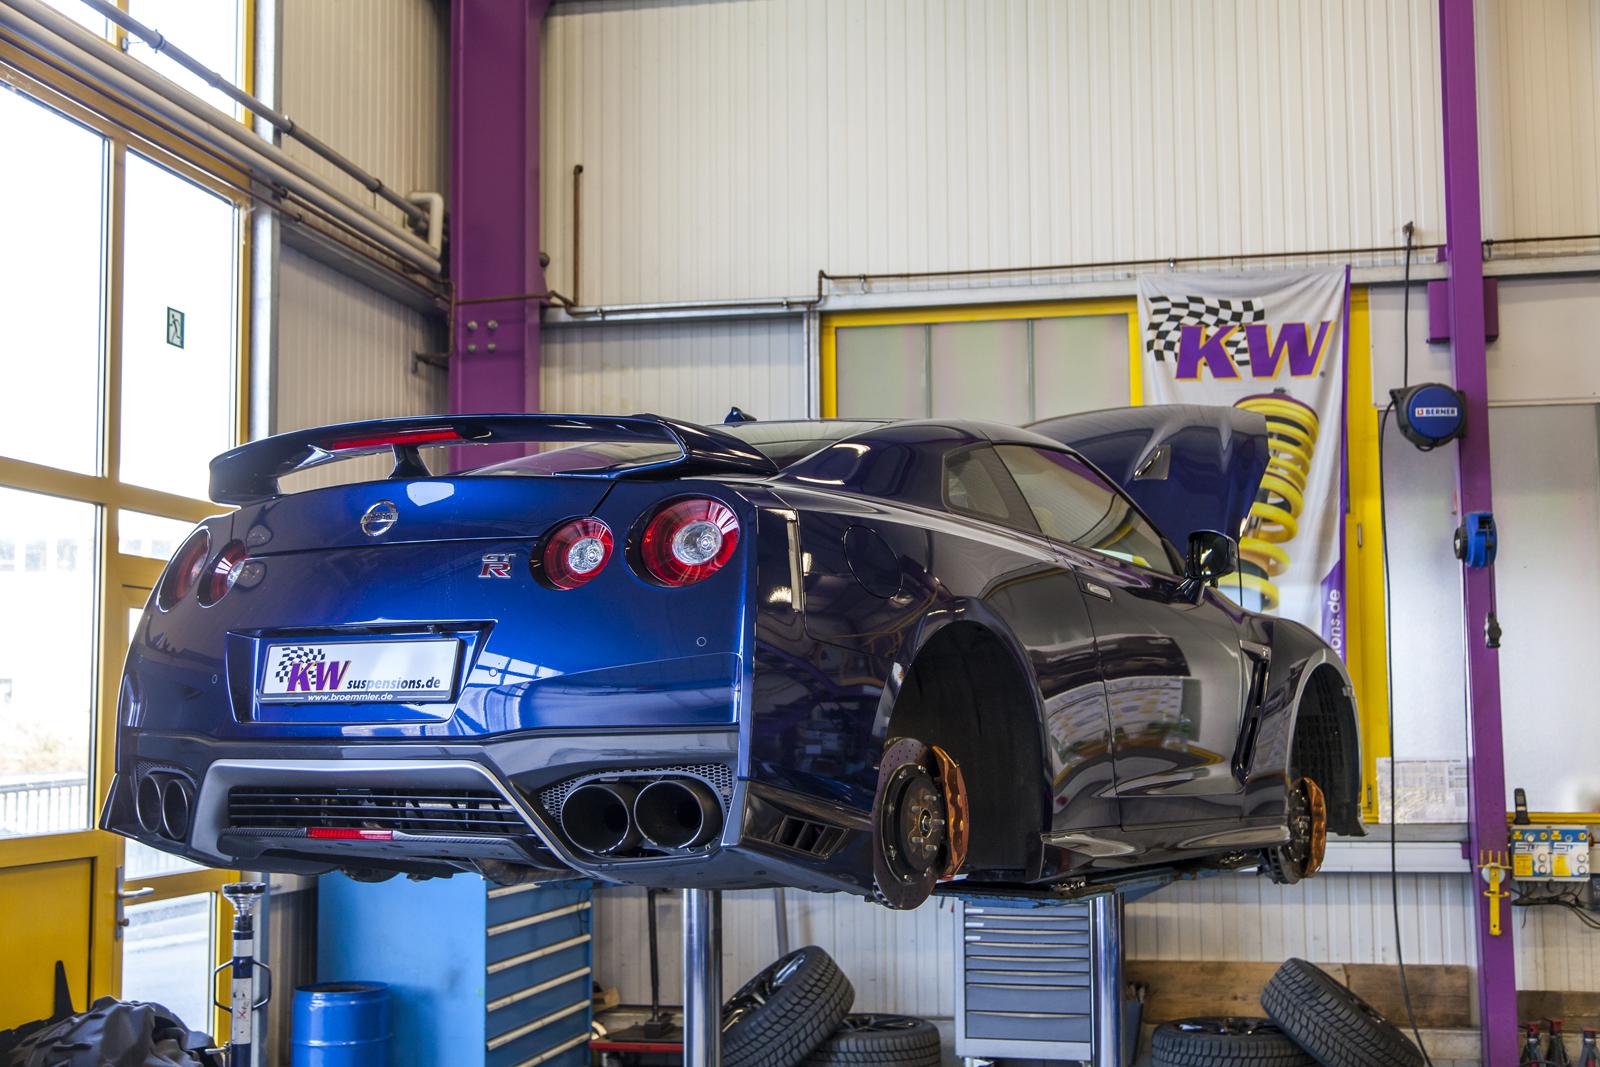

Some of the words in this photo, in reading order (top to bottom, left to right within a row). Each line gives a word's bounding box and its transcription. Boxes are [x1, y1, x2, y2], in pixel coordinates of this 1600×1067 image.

[1175, 321, 1334, 381] KW
[287, 660, 350, 692] KW
[347, 676, 441, 692] suspensions.de
[307, 692, 394, 702] www.broemmler.de
